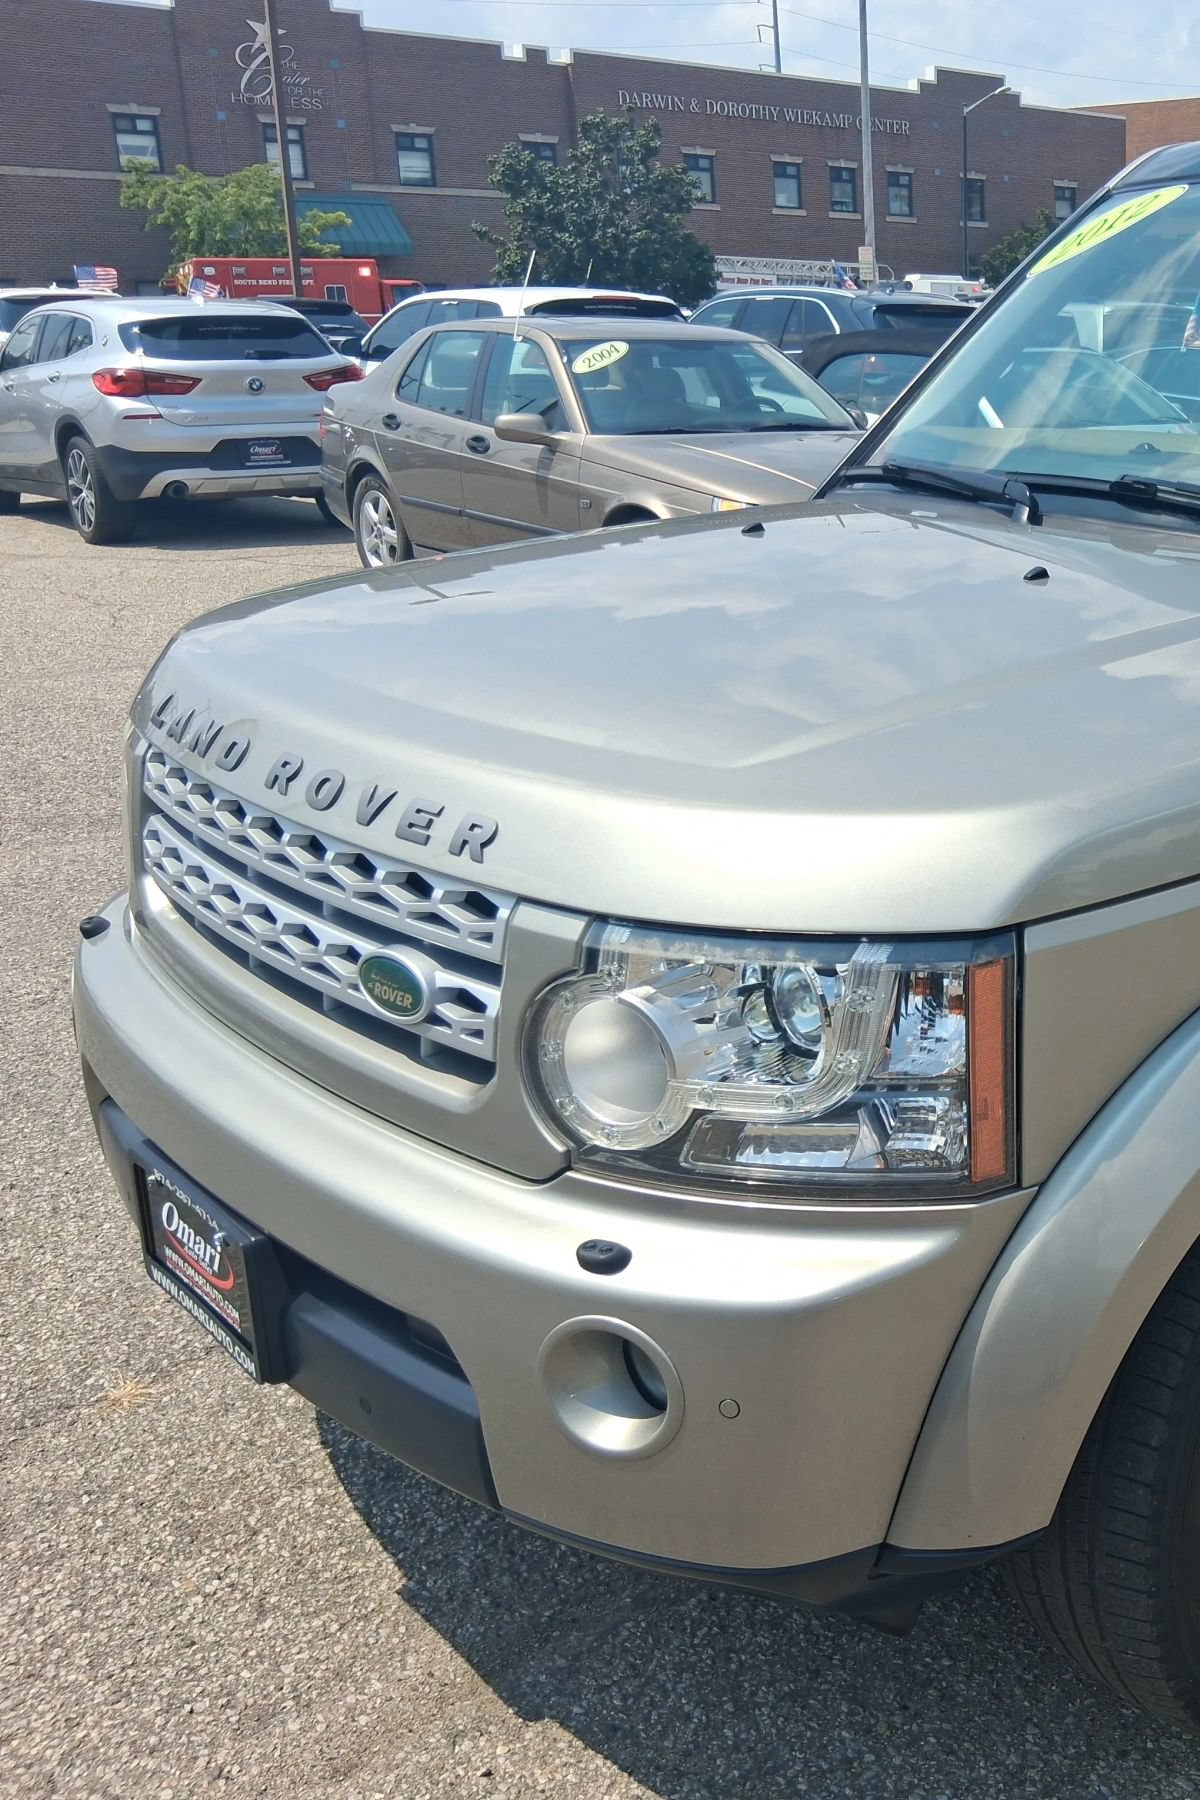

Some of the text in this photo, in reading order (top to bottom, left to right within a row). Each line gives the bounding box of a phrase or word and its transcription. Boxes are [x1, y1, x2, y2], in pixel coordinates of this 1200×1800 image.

[618, 90, 685, 112] DARWIN
[689, 97, 701, 113] &
[705, 99, 780, 121] DOROTHY
[783, 107, 853, 128] WIEKAMP
[1048, 193, 1160, 265] 2012
[582, 344, 620, 368] 2004
[151, 694, 499, 864] LAND ROVER
[374, 982, 413, 1009] ROVER
[162, 1202, 221, 1273] Omari
[164, 1244, 240, 1322] WWW.OMARIAUTO.COM
[151, 1265, 256, 1378] WWW.OMARIAUTO.COM
